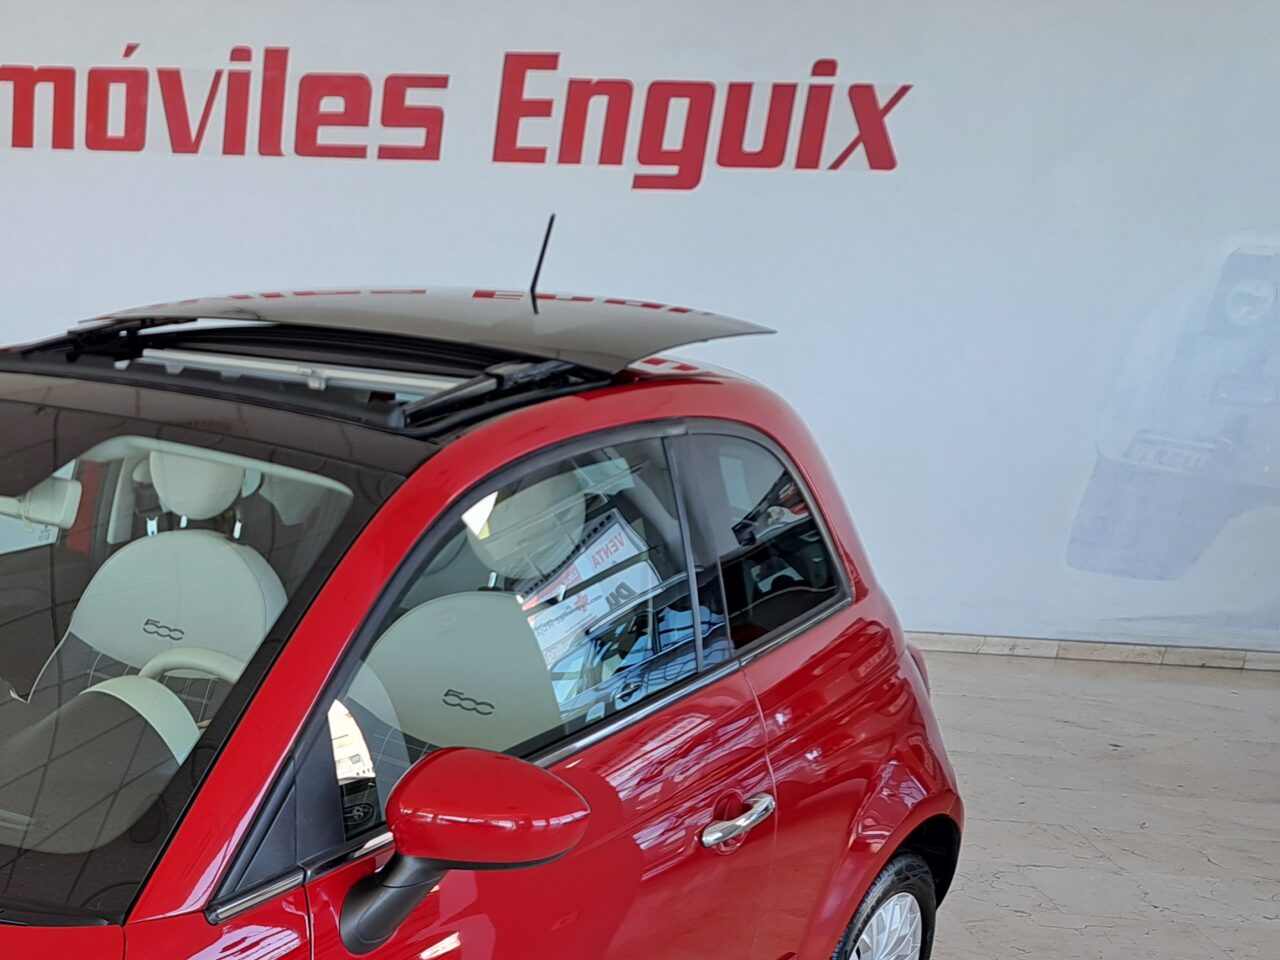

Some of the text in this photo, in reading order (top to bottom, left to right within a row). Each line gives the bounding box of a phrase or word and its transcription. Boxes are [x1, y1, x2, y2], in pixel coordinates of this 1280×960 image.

[491, 50, 913, 191] Enguix
[143, 618, 185, 641] 500
[442, 688, 495, 716] 500
